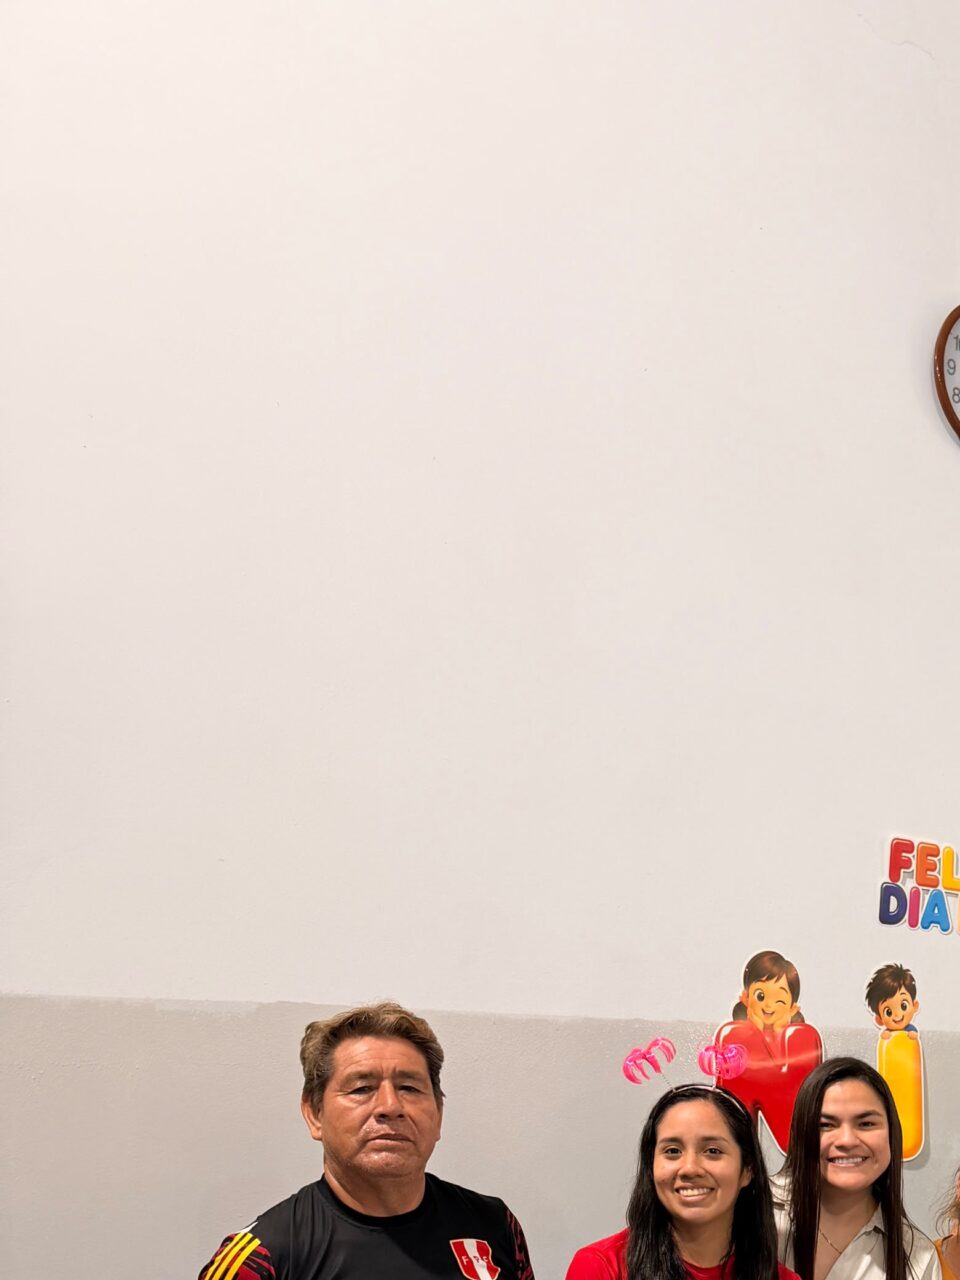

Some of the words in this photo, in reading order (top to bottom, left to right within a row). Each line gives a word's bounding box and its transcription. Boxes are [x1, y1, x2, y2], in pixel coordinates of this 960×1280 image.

[946, 358, 956, 376] 9
[952, 387, 960, 404] 8
[878, 881, 951, 933] DIA
